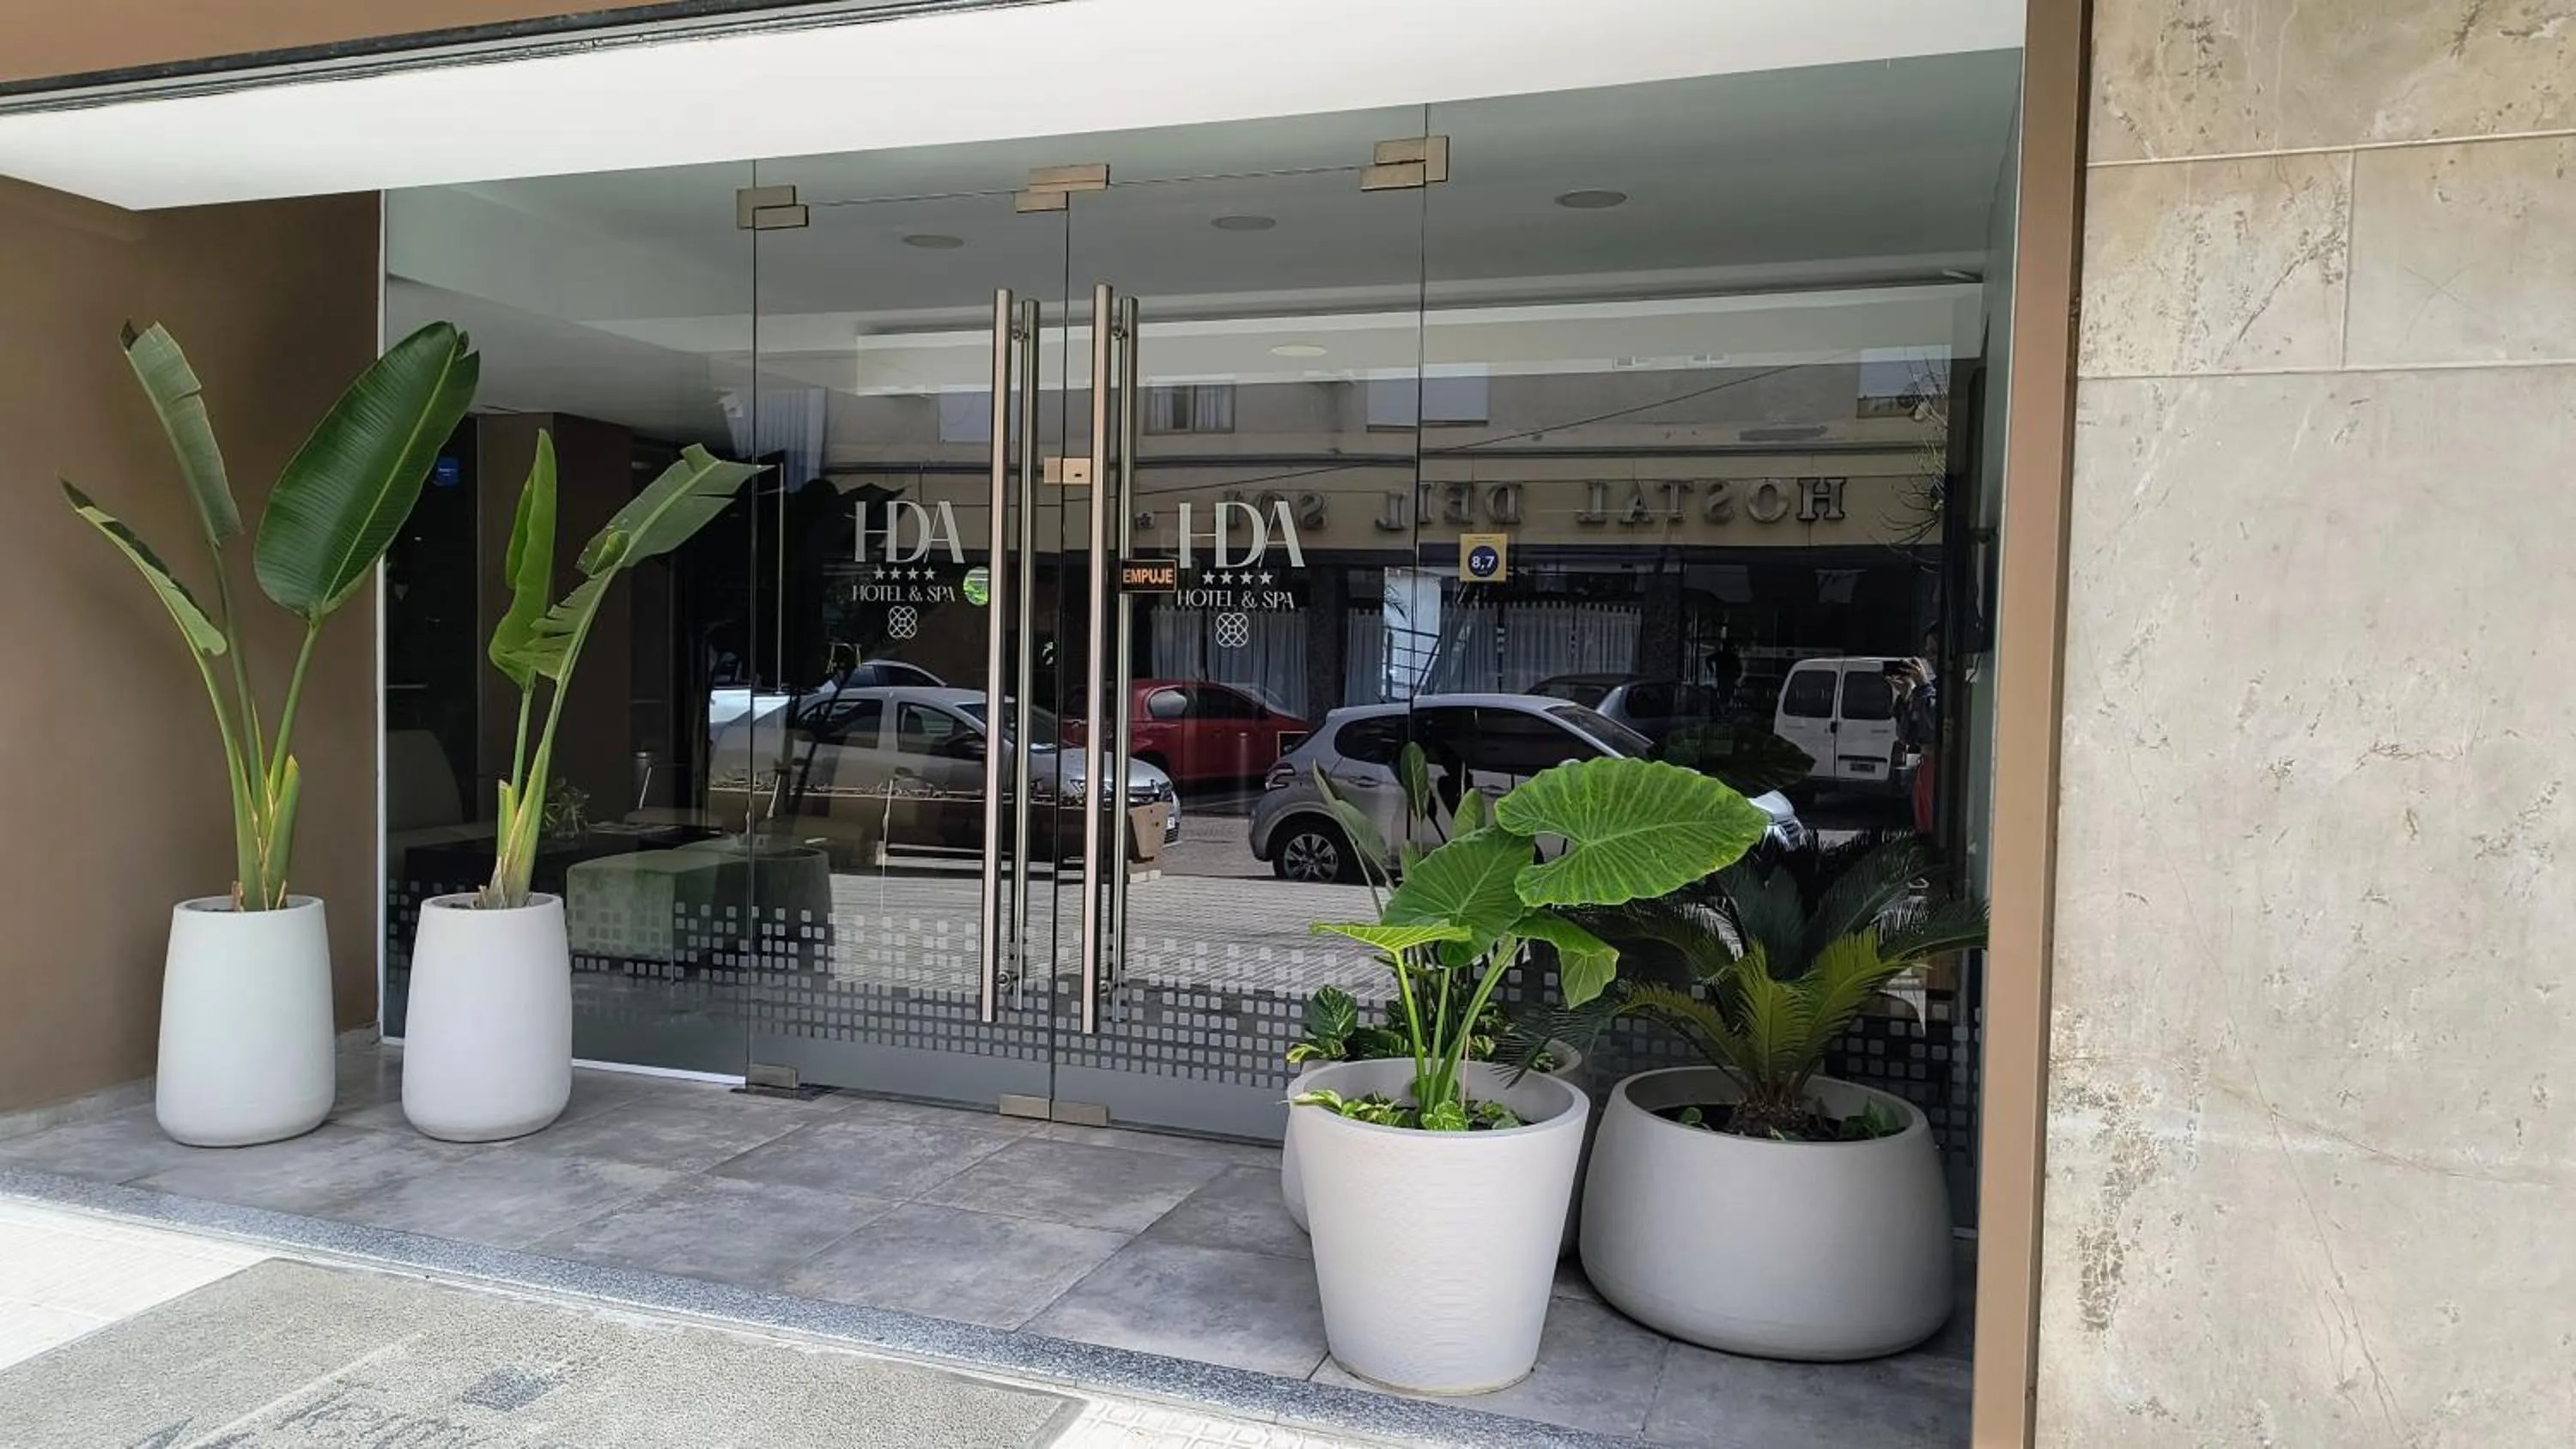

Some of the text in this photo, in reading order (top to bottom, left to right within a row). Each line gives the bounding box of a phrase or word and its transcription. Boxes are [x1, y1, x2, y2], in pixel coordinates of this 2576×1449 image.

[854, 500, 965, 563] HDA
[1179, 500, 1305, 569] HDA
[1472, 555, 1495, 570] 8,7
[1122, 568, 1175, 585] EMPUJE
[852, 585, 956, 603] HOTEL & SPA
[1177, 590, 1295, 609] HOTEL & SPA
